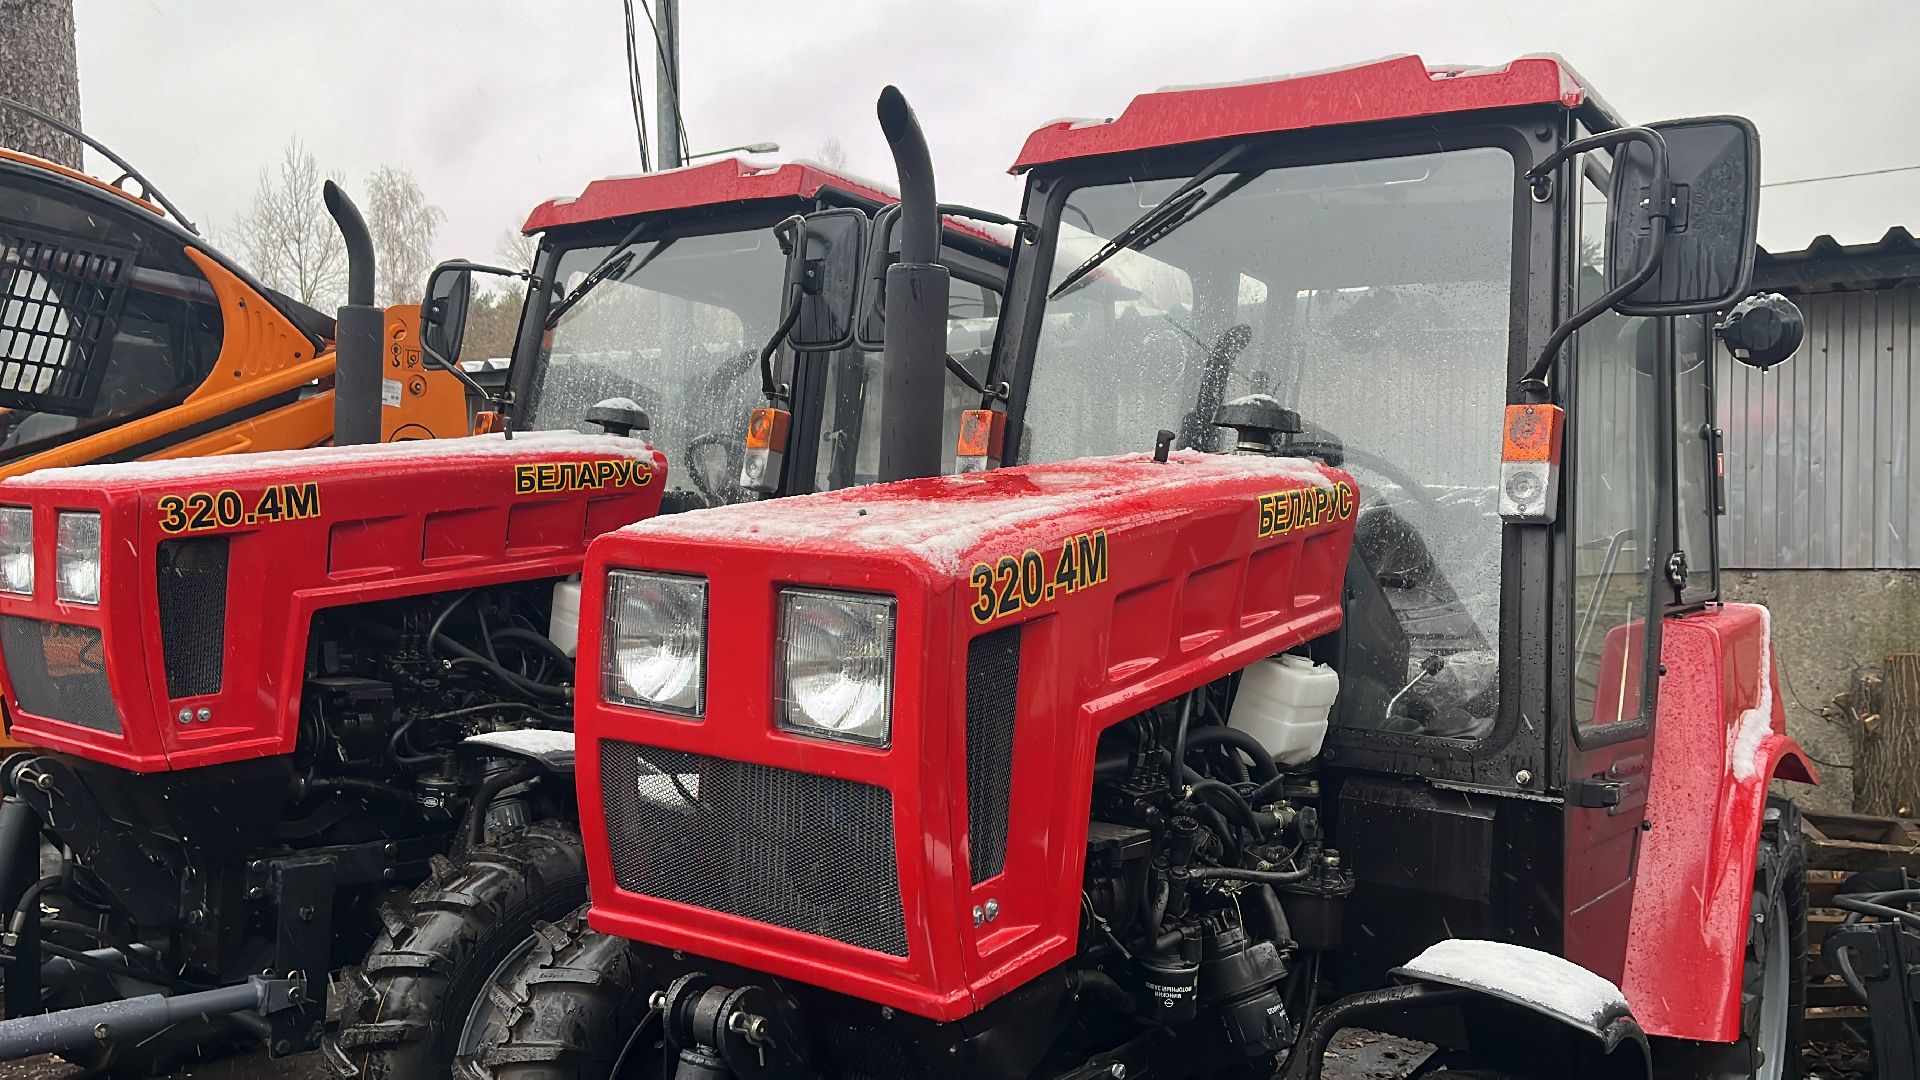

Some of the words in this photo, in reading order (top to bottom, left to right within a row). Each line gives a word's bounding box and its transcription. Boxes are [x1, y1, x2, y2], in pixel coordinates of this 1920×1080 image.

[515, 458, 652, 495] БЕЛАРУС
[157, 480, 321, 534] 320.4М
[1258, 480, 1353, 538] БЕЛАРУС
[970, 527, 1108, 624] 320.4М
